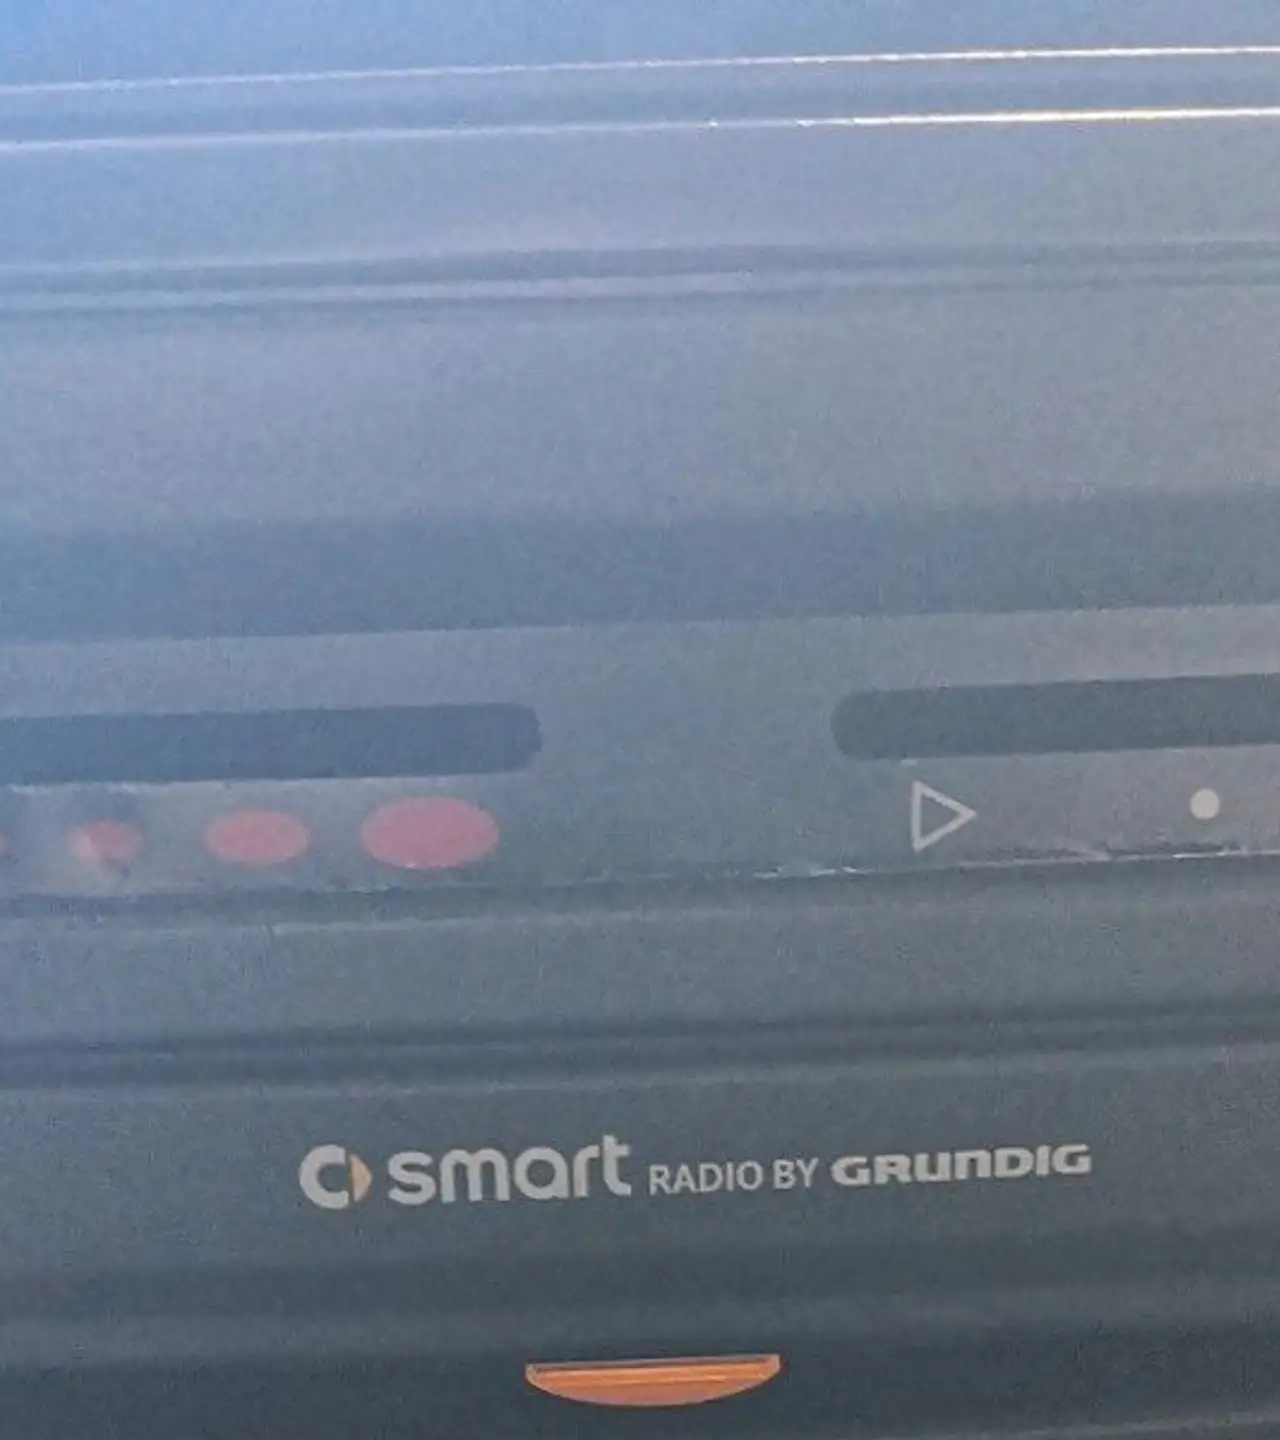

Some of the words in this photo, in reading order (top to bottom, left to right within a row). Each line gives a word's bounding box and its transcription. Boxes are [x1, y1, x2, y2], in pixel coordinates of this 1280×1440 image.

[388, 1135, 631, 1203] smart
[649, 1160, 765, 1196] RADIO
[773, 1158, 819, 1190] BY
[831, 1144, 1092, 1187] GRUNDIG
